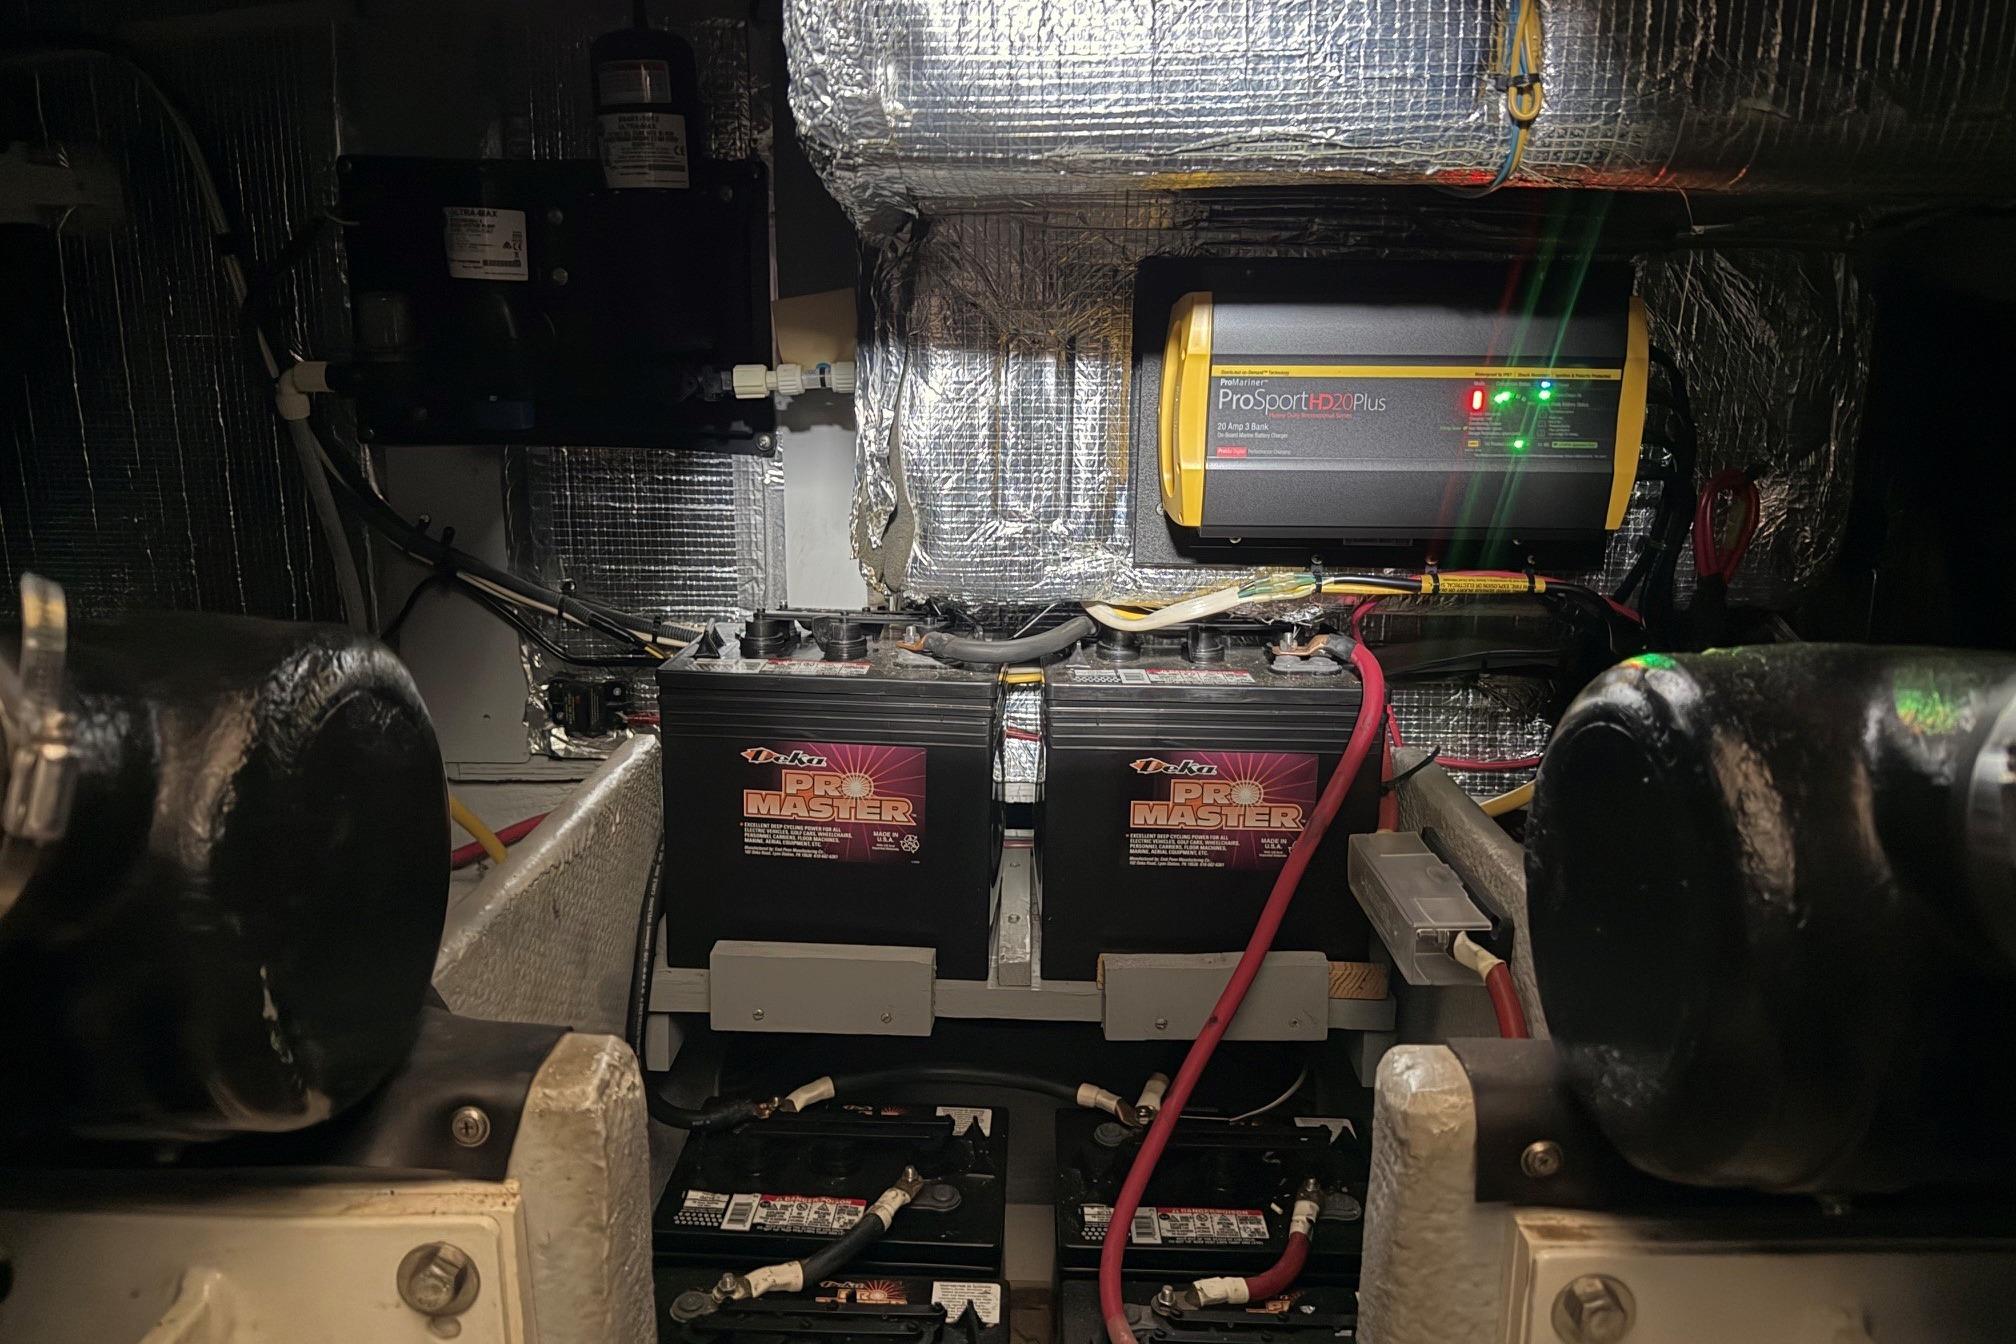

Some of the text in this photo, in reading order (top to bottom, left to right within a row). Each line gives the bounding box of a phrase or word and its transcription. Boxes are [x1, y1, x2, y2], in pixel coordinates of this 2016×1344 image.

[1227, 422, 1244, 432] Amp
[1251, 422, 1269, 430] Bank
[783, 770, 874, 800] PRO
[1172, 780, 1263, 806] PRO
